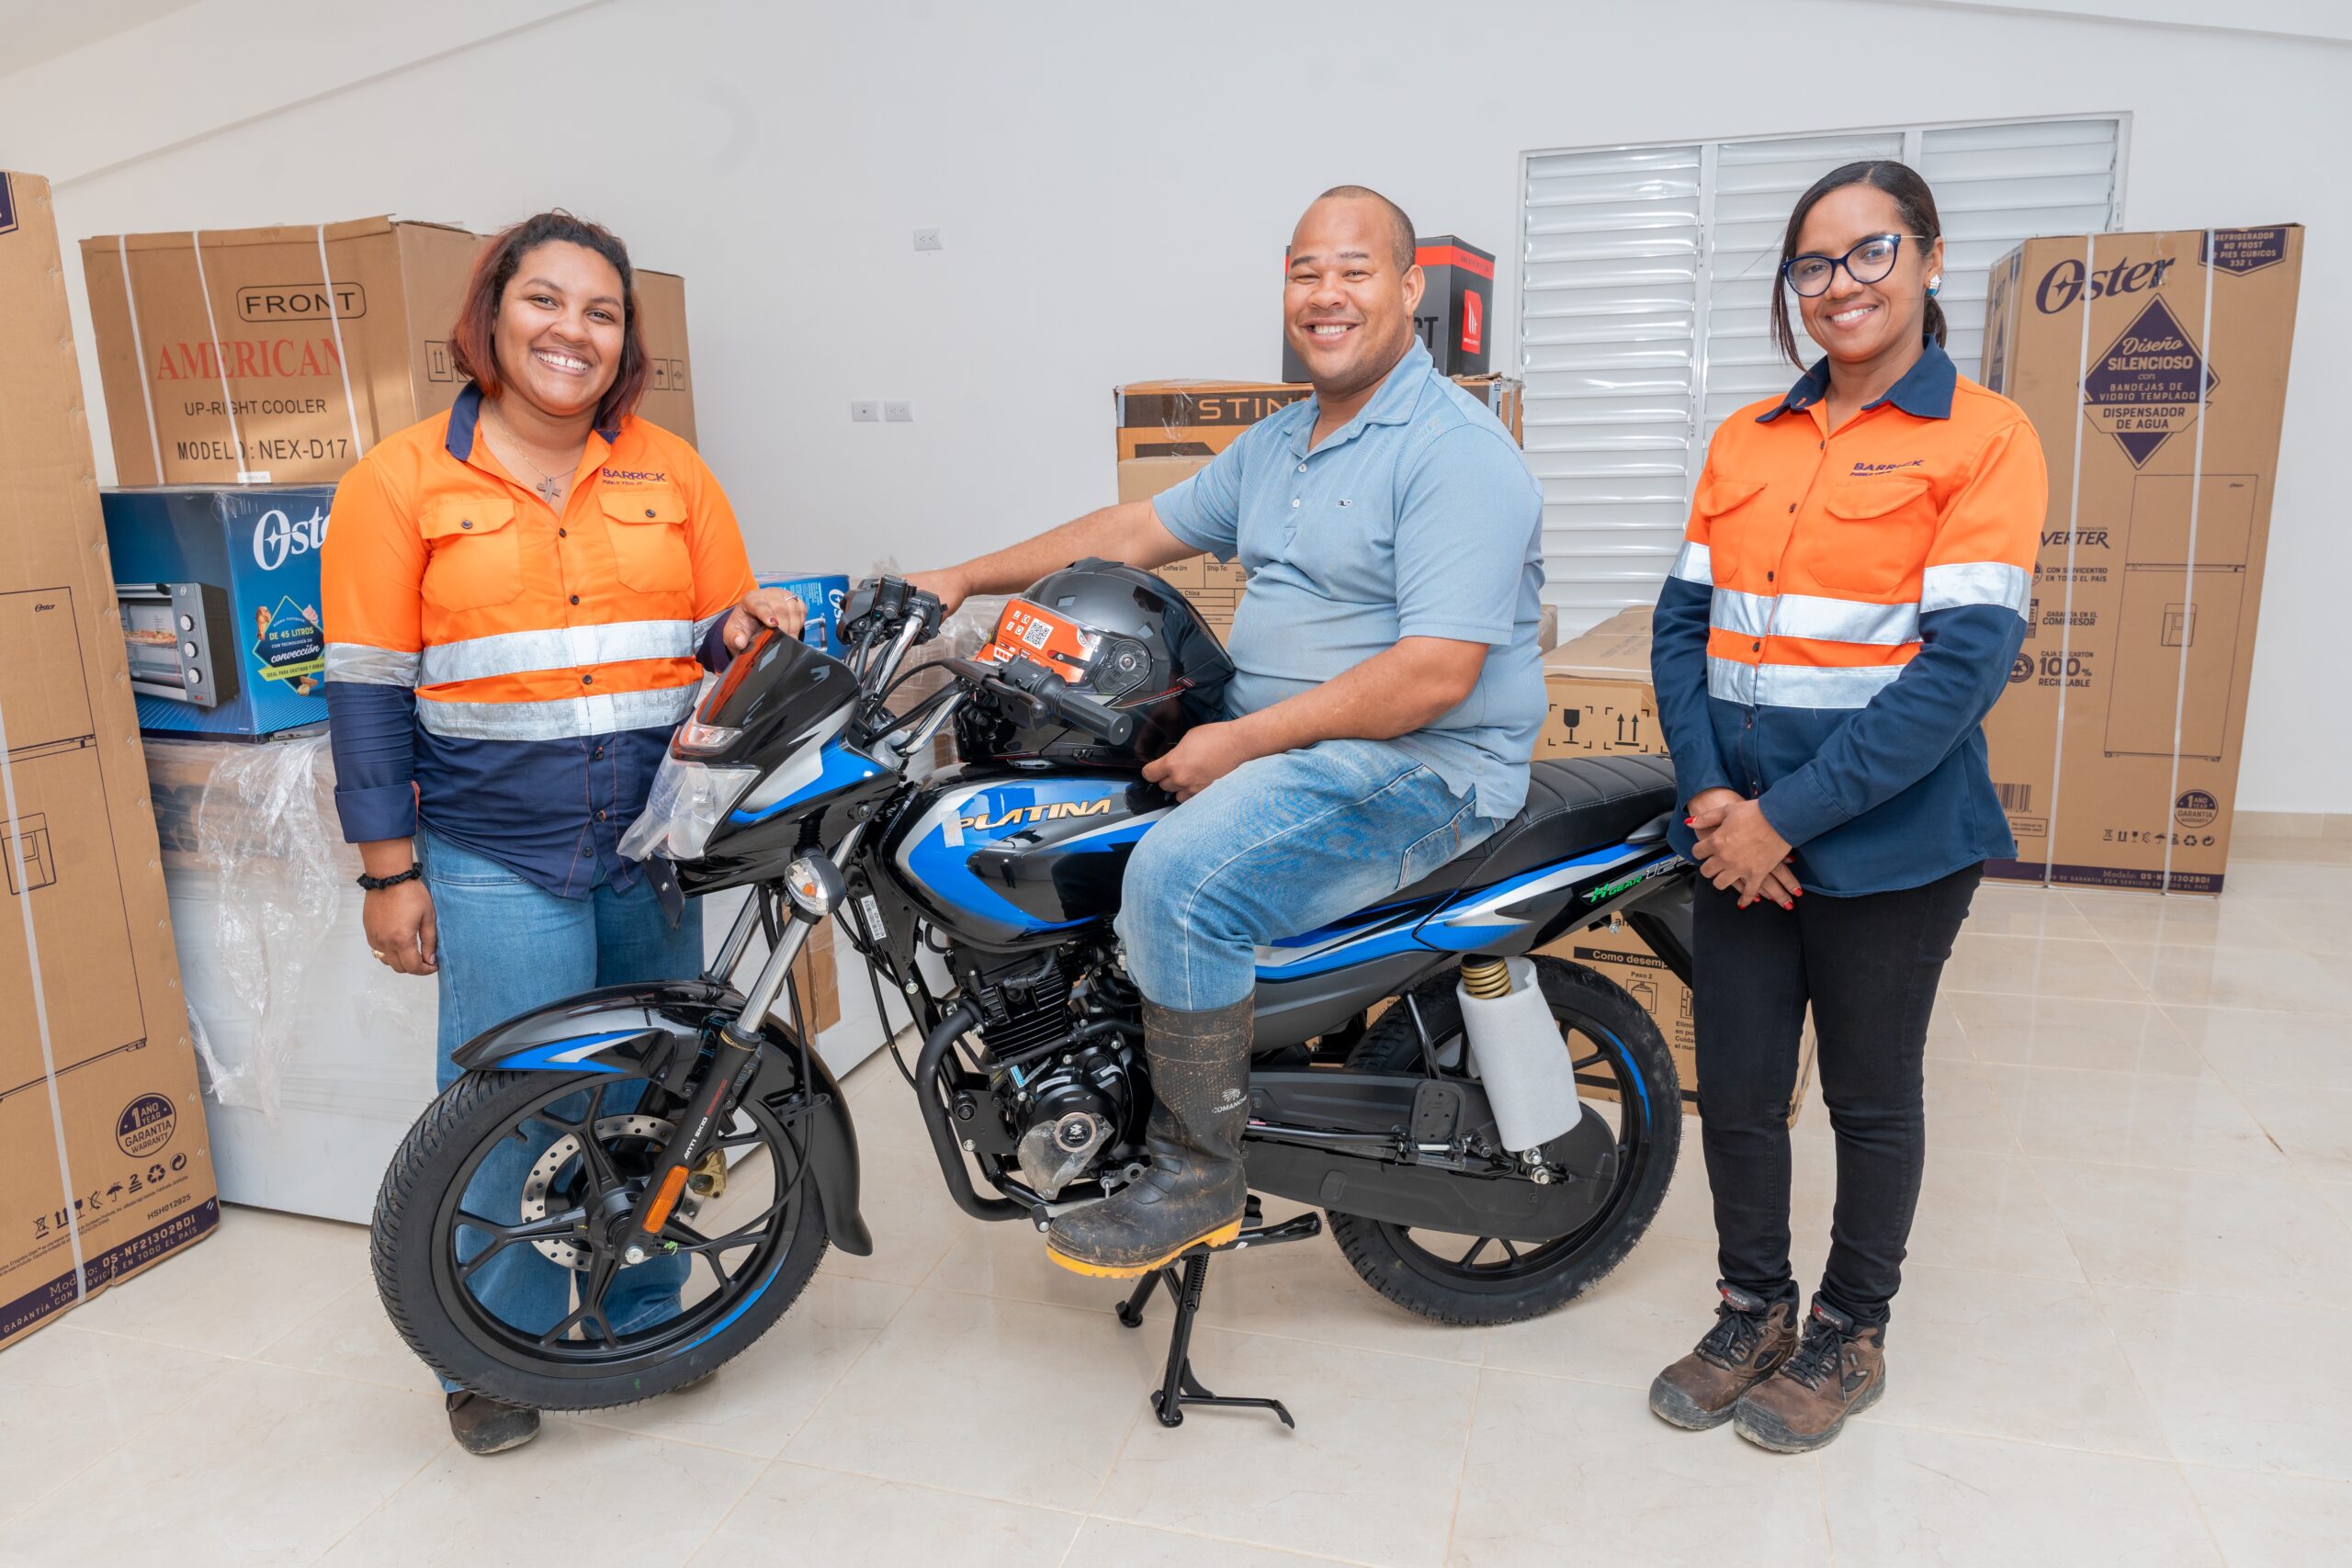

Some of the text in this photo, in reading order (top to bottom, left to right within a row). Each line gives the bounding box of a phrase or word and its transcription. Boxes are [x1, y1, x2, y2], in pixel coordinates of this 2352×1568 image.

[2215, 231, 2275, 241] REFRIGERADOR
[2238, 241, 2264, 249] FROST
[2220, 250, 2238, 258] PIES
[2035, 256, 2176, 315] Oster
[244, 291, 356, 314] FRONT
[2121, 336, 2184, 355] Diseño
[2107, 355, 2194, 371] SILENCIOSO
[2109, 382, 2183, 392] BANDEJAS DE
[2099, 391, 2197, 401] VIDRIO TEMPLADO
[184, 398, 327, 416] UP-RIGHT COOLER
[1198, 397, 1311, 420] STIN
[2103, 407, 2186, 418] DISPENSADOR
[2116, 419, 2169, 429] DE AGUA
[259, 438, 347, 460] NEX-D17
[1852, 460, 1925, 471] BARRK
[602, 468, 667, 481] BARRICK
[2042, 617, 2096, 626] COMRESOR
[269, 626, 314, 641] DE 45 LITROS
[270, 644, 321, 663] convección
[2038, 678, 2091, 687] RECILABLE
[960, 798, 1112, 830] PLATINA
[2102, 870, 2137, 879] Modelo:
[1592, 950, 1624, 963] Como
[1631, 971, 1647, 979] Paso
[141, 1101, 159, 1117] AÑO
[131, 1107, 141, 1128] 1
[141, 1111, 161, 1125] YEAR
[130, 1133, 168, 1154] WARRANTY
[4, 1225, 198, 1334] GARANTÍA CON RVICIO EN TODO EL PAÍS
[49, 1267, 97, 1298] Modo:
